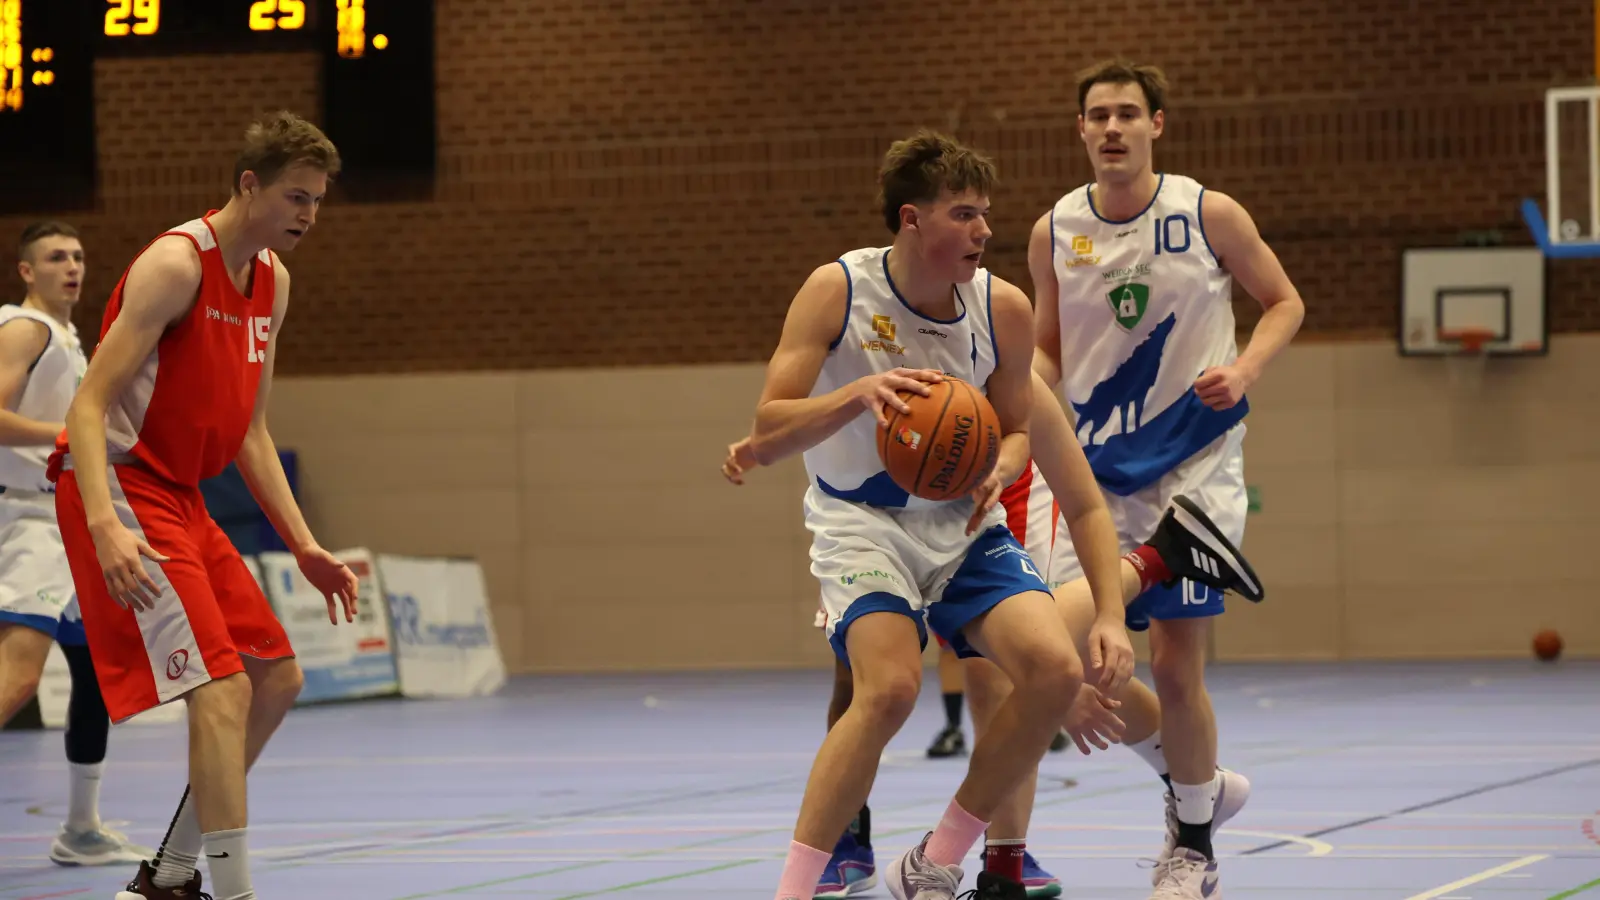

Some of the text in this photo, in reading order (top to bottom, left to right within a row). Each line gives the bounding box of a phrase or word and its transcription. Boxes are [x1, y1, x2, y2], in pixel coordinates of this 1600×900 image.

[104, 0, 160, 36] 29
[249, 0, 305, 31] 25
[1154, 214, 1191, 255] 10
[860, 340, 905, 356] WENEX
[929, 413, 974, 492] SPALDING
[1182, 576, 1209, 605] 10
